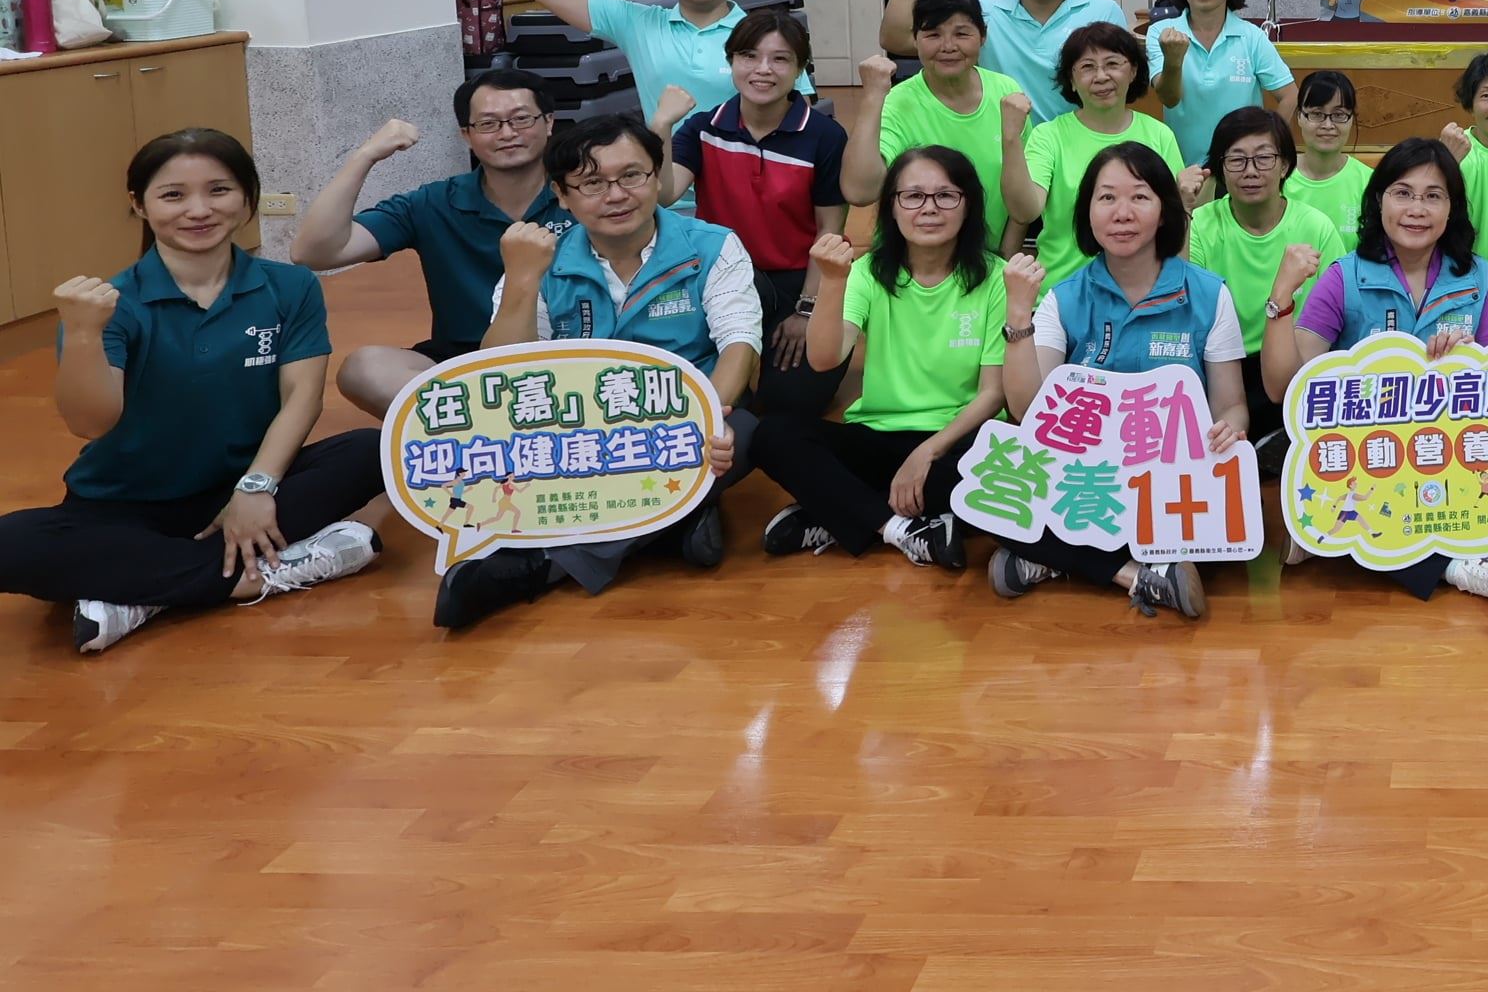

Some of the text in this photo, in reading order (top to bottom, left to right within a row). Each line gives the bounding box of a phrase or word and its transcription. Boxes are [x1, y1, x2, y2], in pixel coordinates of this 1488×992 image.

[418, 366, 689, 432] 在「嘉」養肌
[1034, 380, 1205, 467] 運動
[406, 425, 702, 487] 迎向健康生活
[536, 490, 598, 503] 嘉義縣政府
[536, 497, 662, 514] 嘉義縣衛生局 關心您 廣告
[537, 512, 600, 525] 南華大學
[1412, 510, 1470, 524] 嘉義縣政府
[1413, 521, 1471, 535] 嘉義縣衛生局
